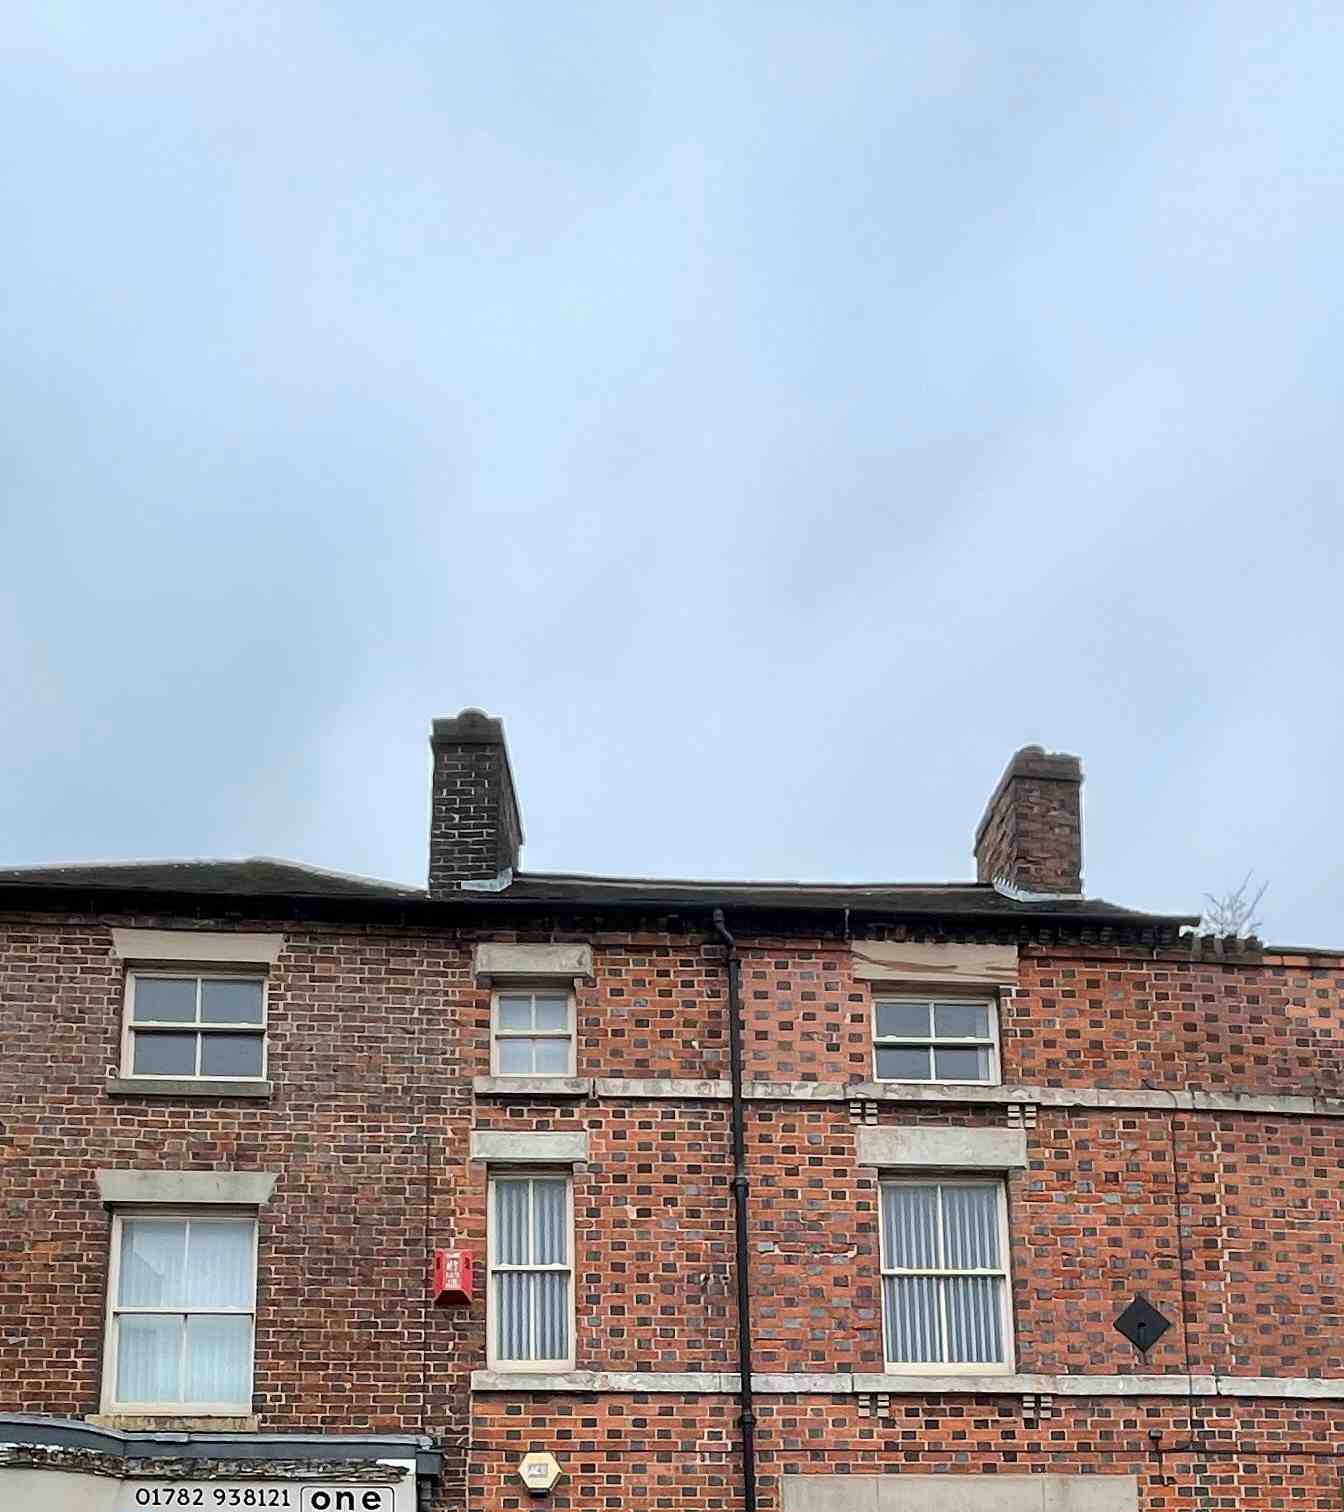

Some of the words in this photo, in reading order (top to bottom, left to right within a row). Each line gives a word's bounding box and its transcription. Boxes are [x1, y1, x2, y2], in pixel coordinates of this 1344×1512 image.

[135, 1487, 204, 1507] 01782
[212, 1487, 291, 1508] 938121
[311, 1489, 381, 1511] one
